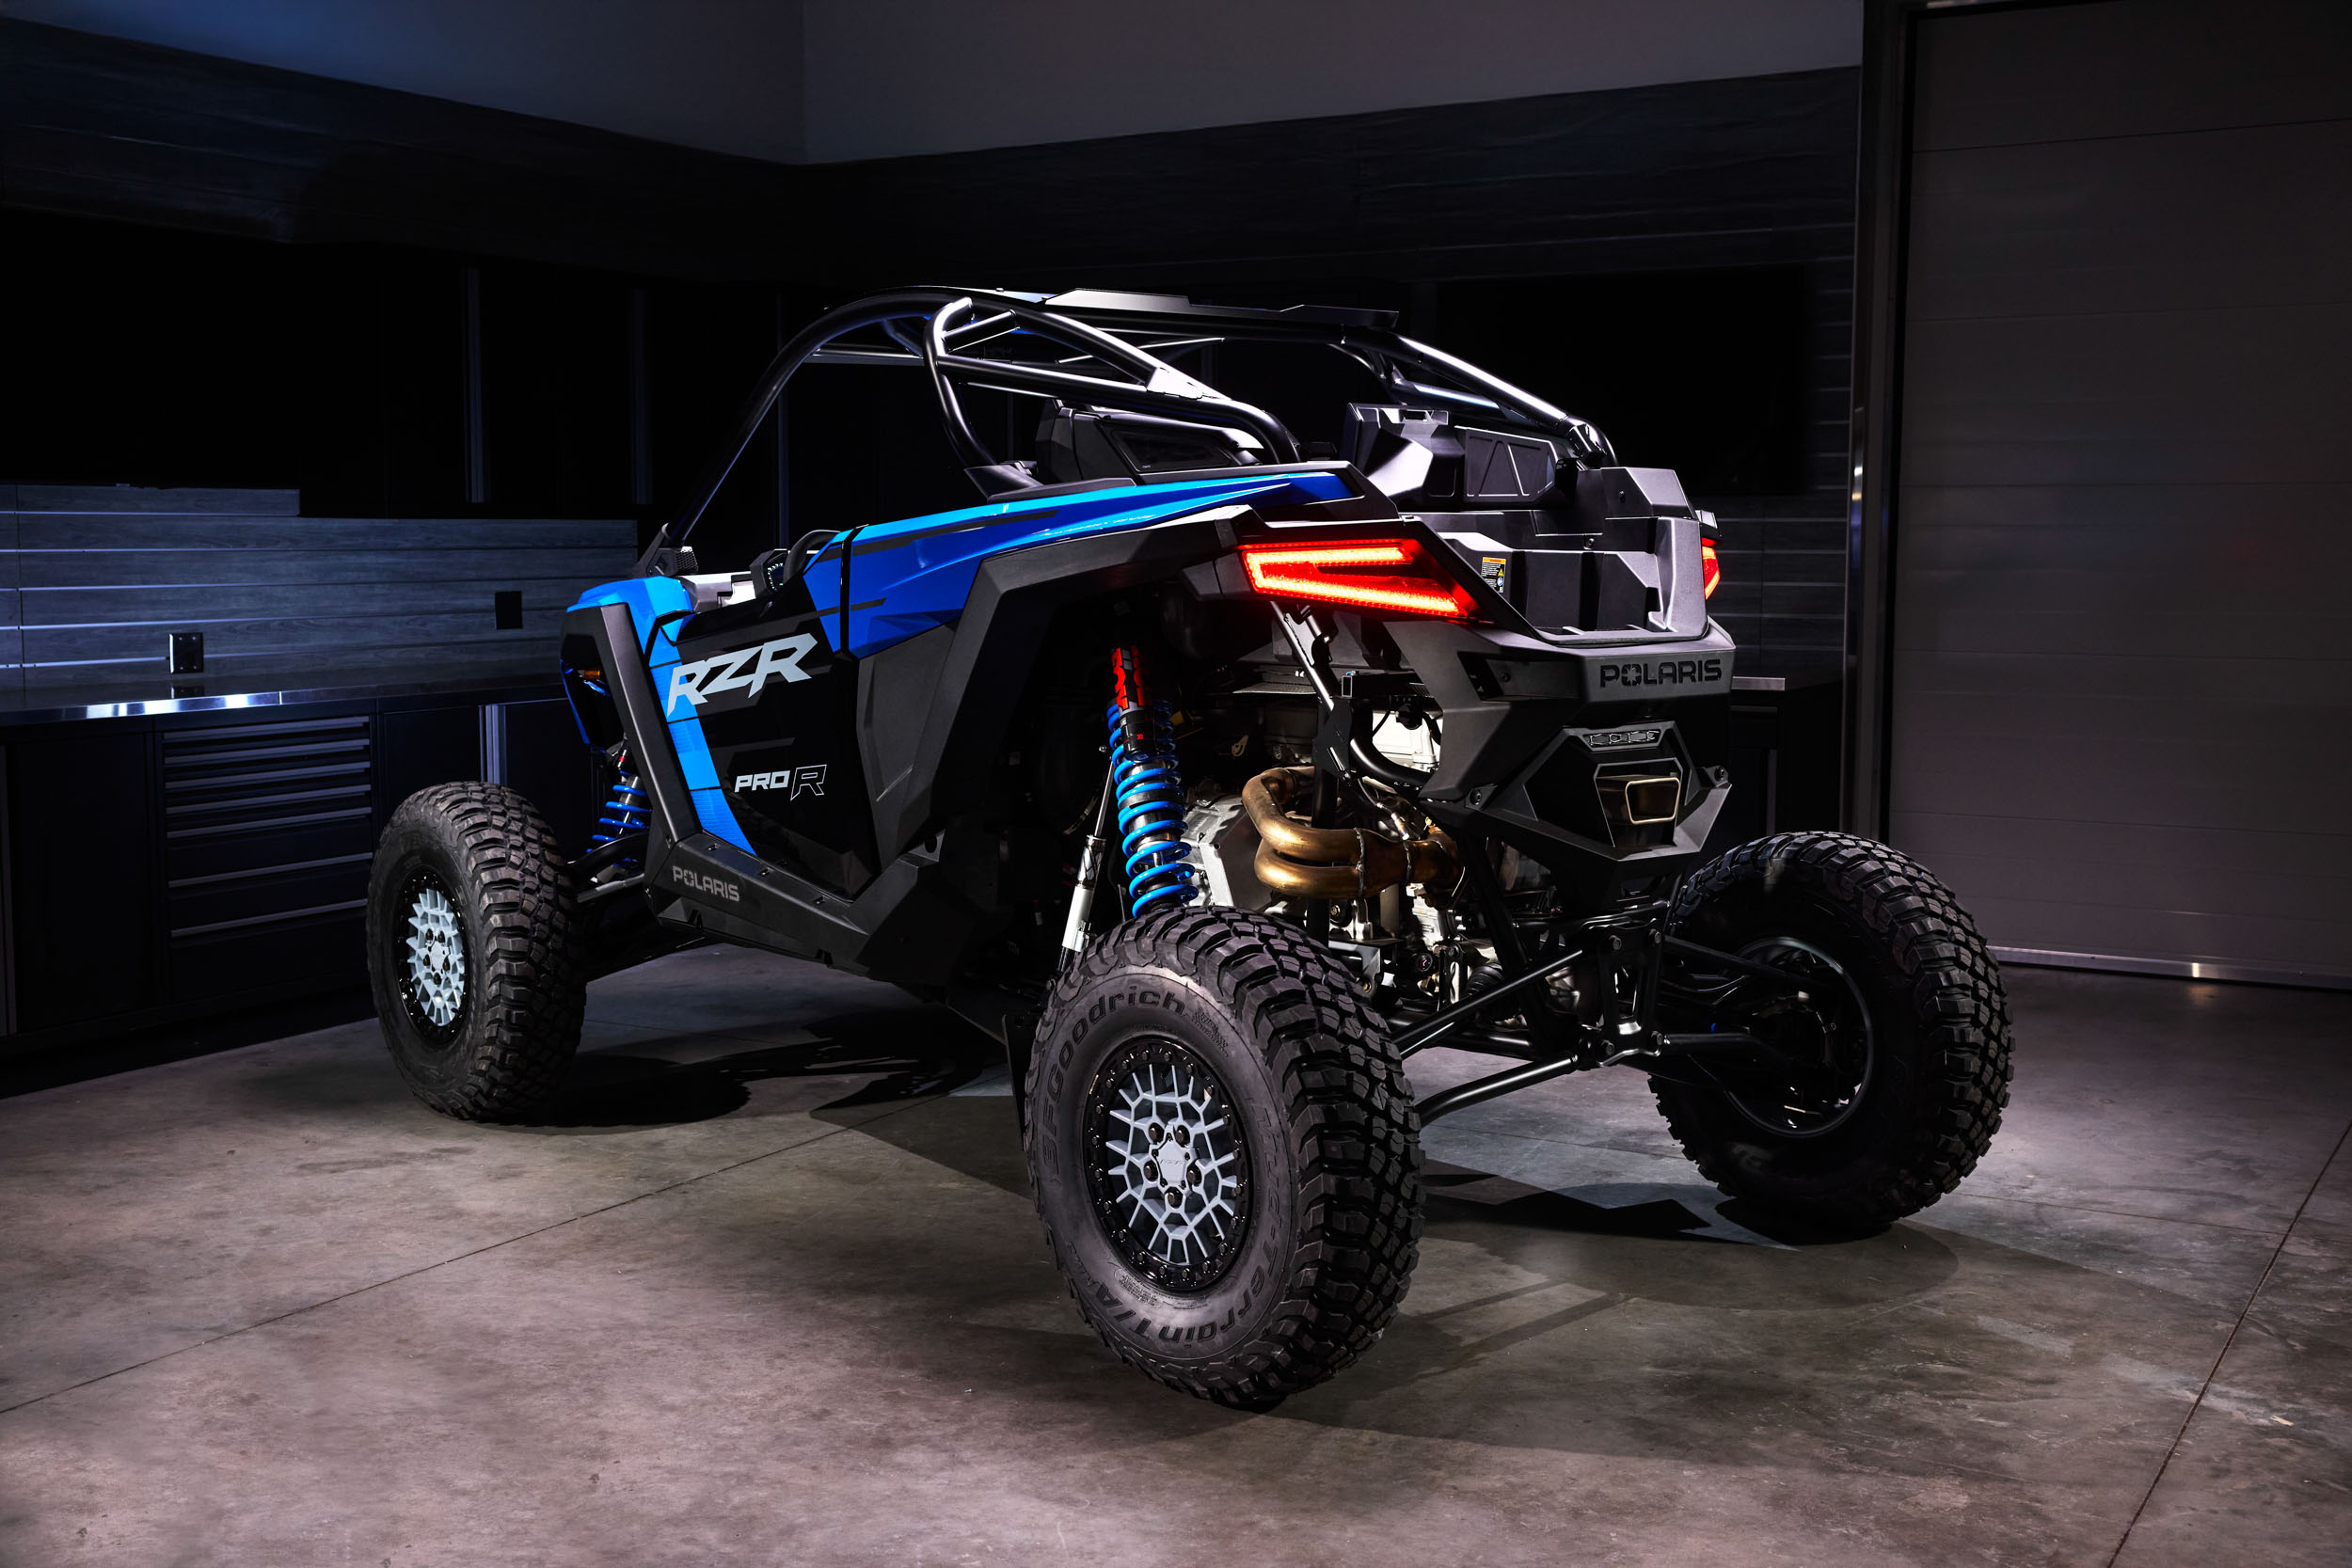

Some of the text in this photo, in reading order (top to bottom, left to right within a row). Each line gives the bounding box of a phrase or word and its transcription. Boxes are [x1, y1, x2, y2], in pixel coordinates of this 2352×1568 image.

[666, 632, 818, 718] RZR
[1600, 659, 1723, 688] POLARIS
[734, 764, 828, 801] PRO R
[672, 865, 740, 902] POLARIS
